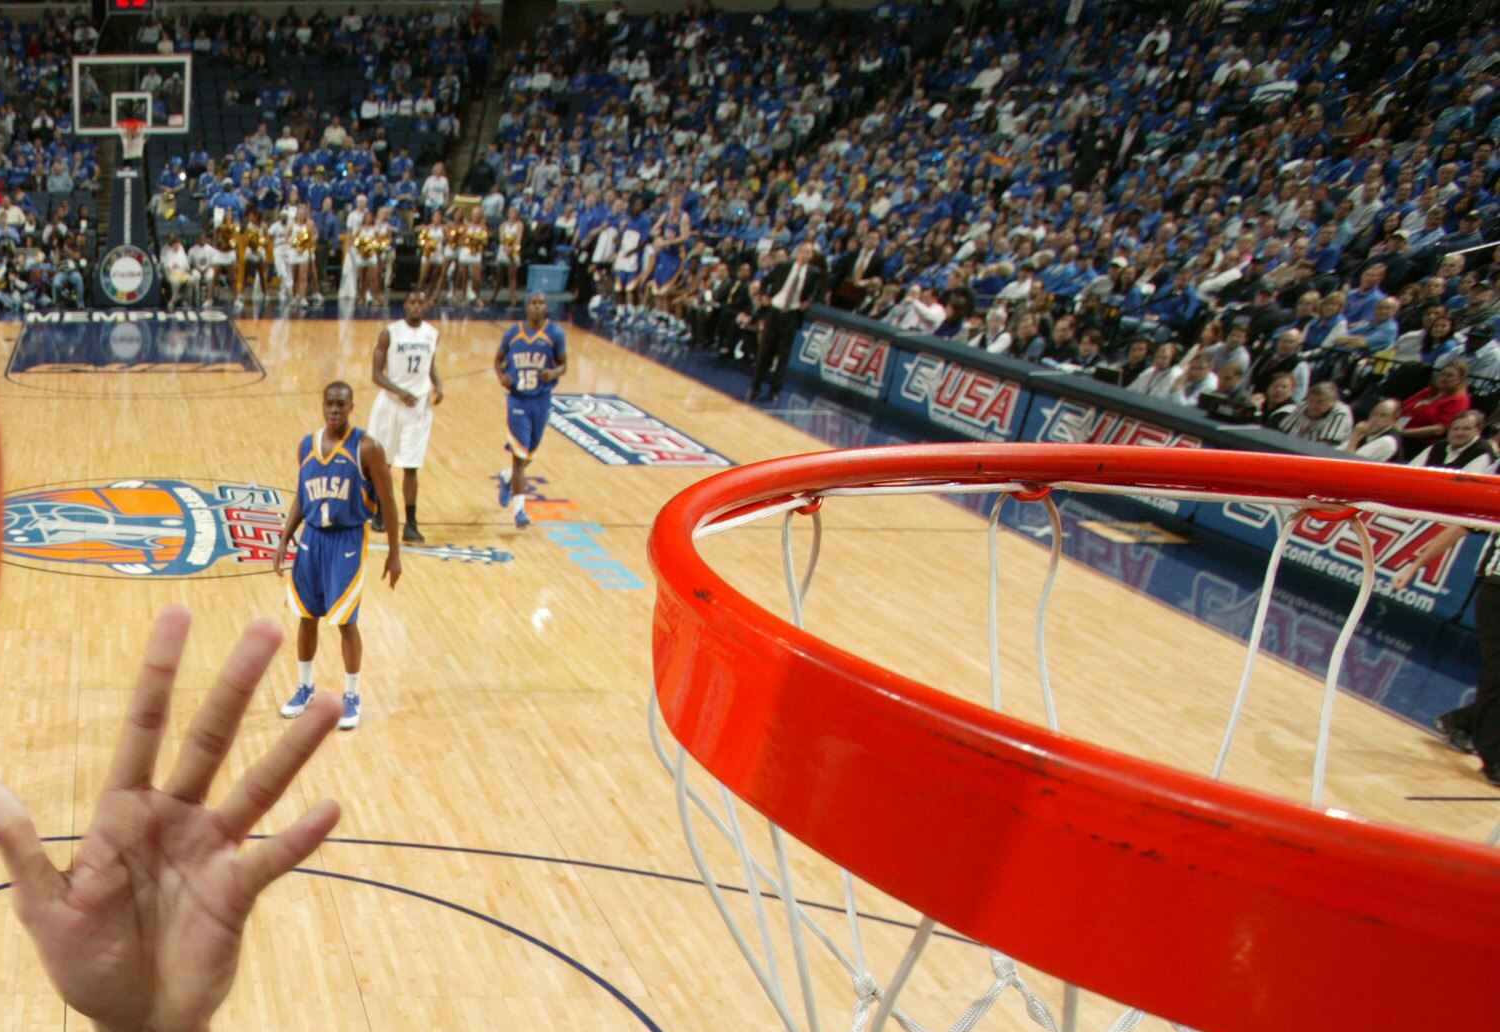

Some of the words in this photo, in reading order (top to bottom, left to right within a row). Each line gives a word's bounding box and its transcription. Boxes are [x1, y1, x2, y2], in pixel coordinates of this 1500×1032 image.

[25, 310, 228, 323] MEMPHIS
[407, 355, 421, 373] 12
[516, 370, 539, 391] 15
[304, 475, 351, 501] TULSA
[319, 502, 333, 528] 1
